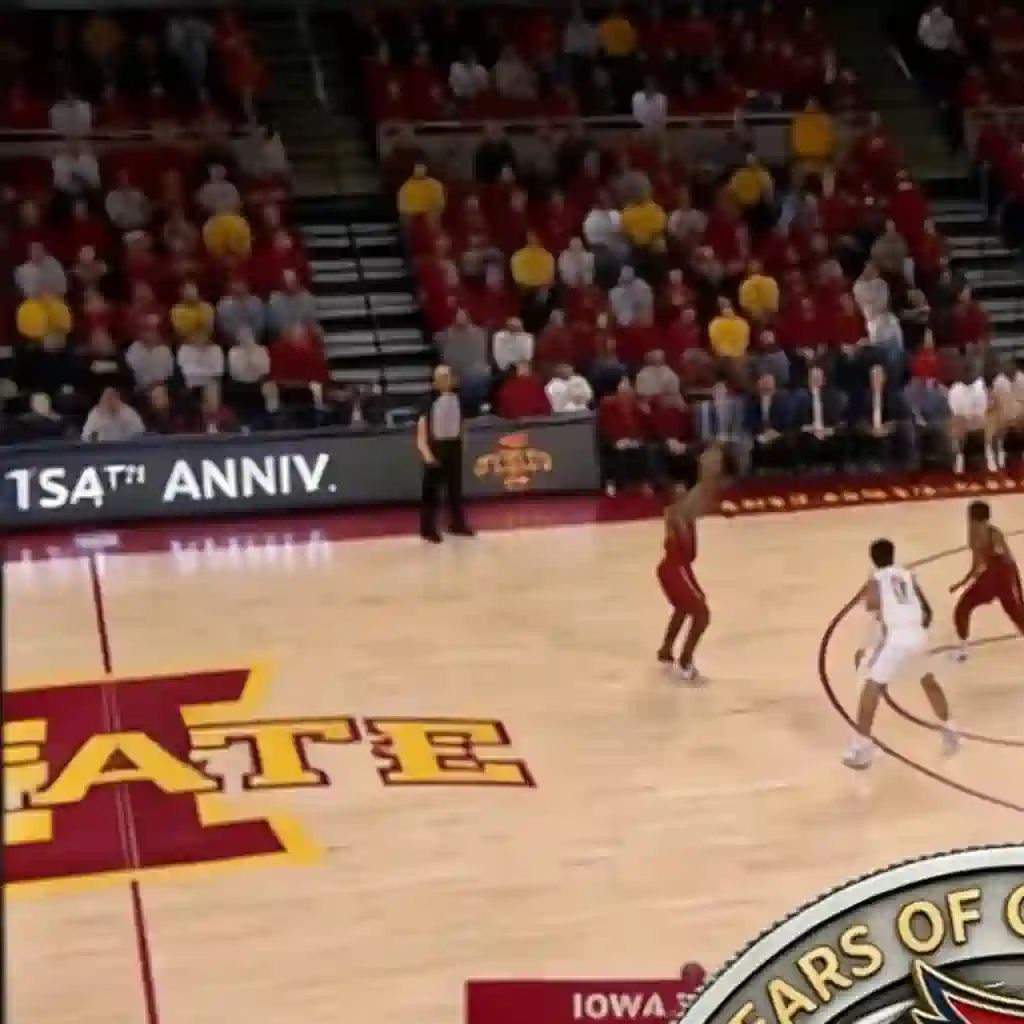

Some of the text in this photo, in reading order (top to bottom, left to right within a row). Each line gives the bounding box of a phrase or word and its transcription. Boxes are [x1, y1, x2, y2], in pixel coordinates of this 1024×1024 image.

[163, 452, 337, 502] ANNIV.
[897, 887, 982, 954] OF
[572, 991, 666, 1020] IOWA
